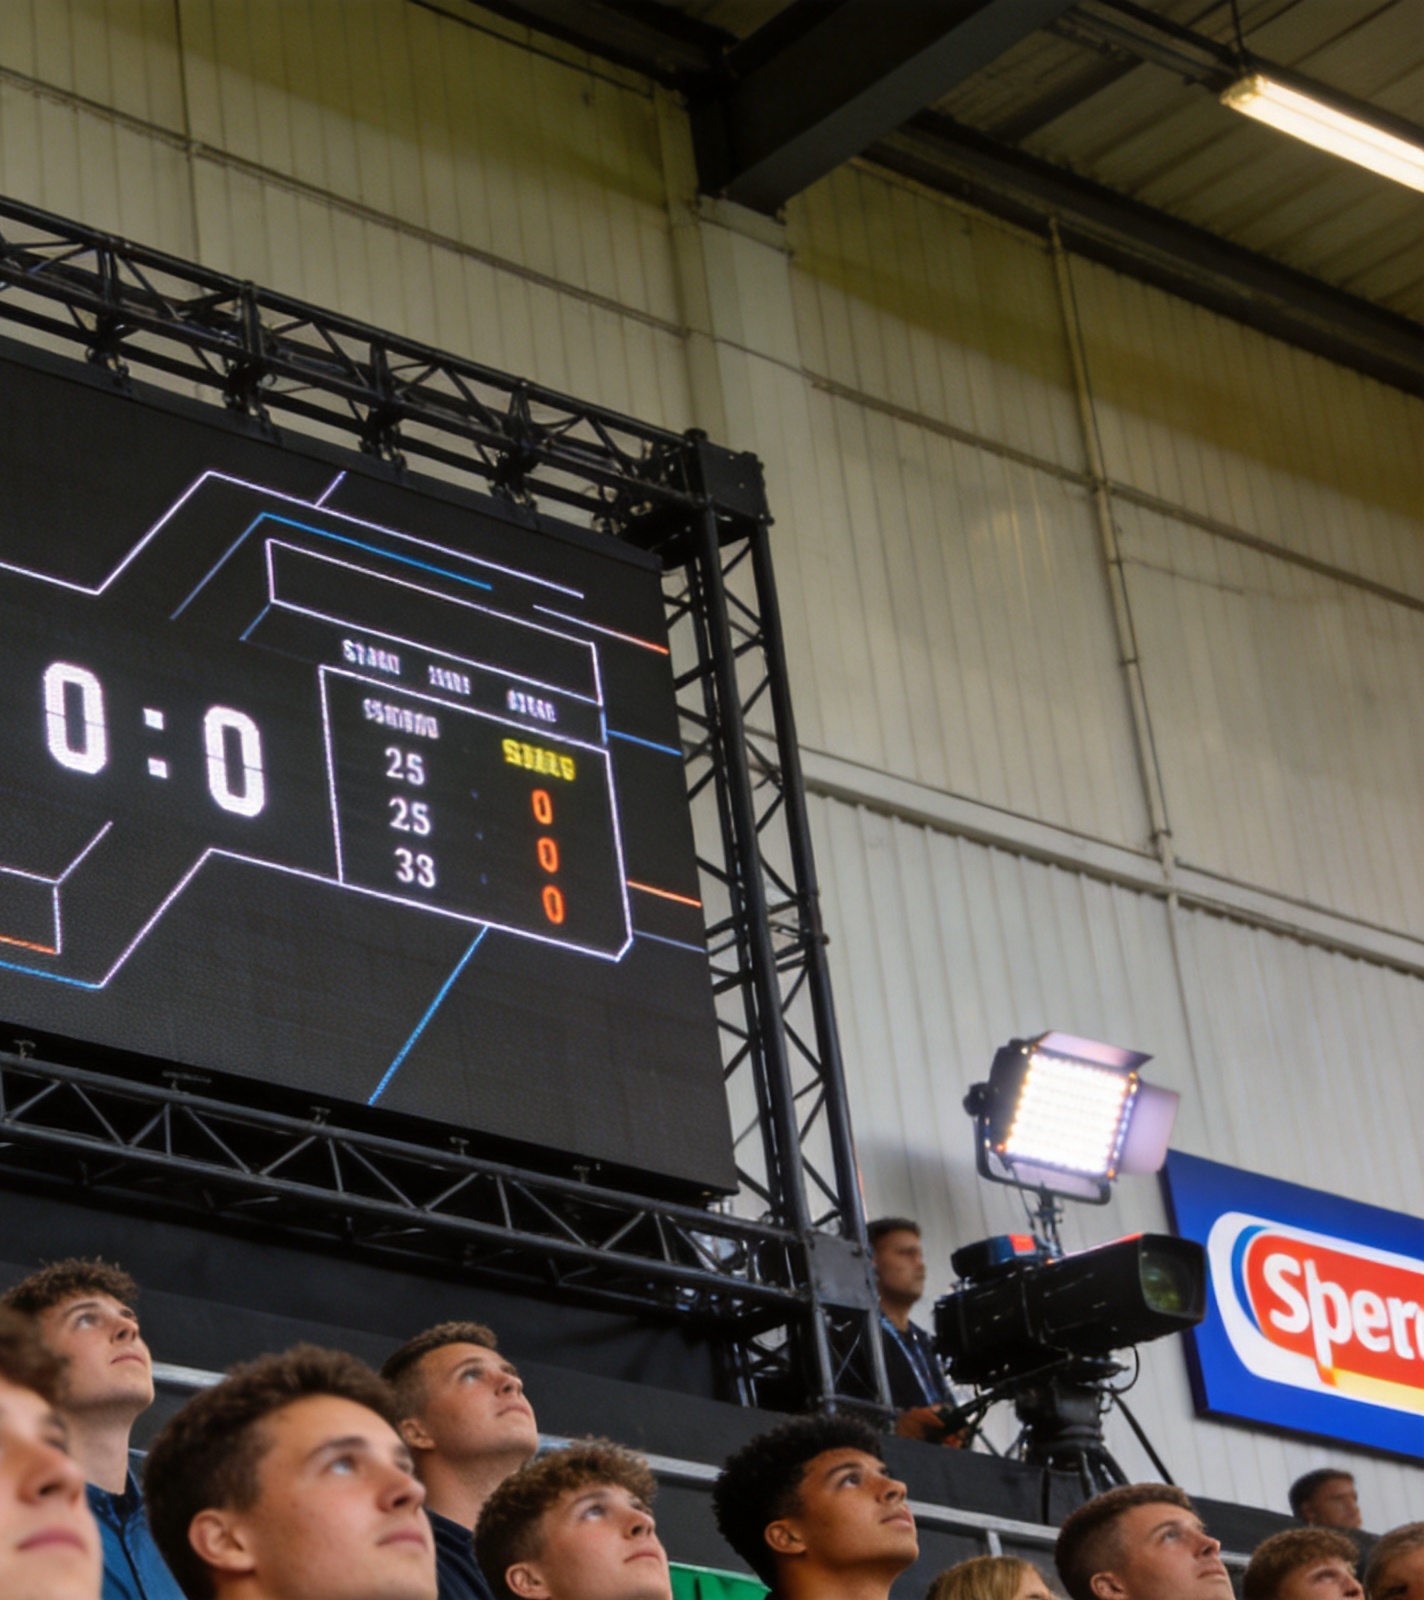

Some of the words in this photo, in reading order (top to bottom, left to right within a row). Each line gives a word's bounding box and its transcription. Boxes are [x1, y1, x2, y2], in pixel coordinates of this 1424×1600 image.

[384, 747, 425, 786] 25
[389, 797, 432, 836] 25
[531, 788, 553, 825] 0
[537, 836, 559, 873] 0
[542, 884, 565, 924] 0
